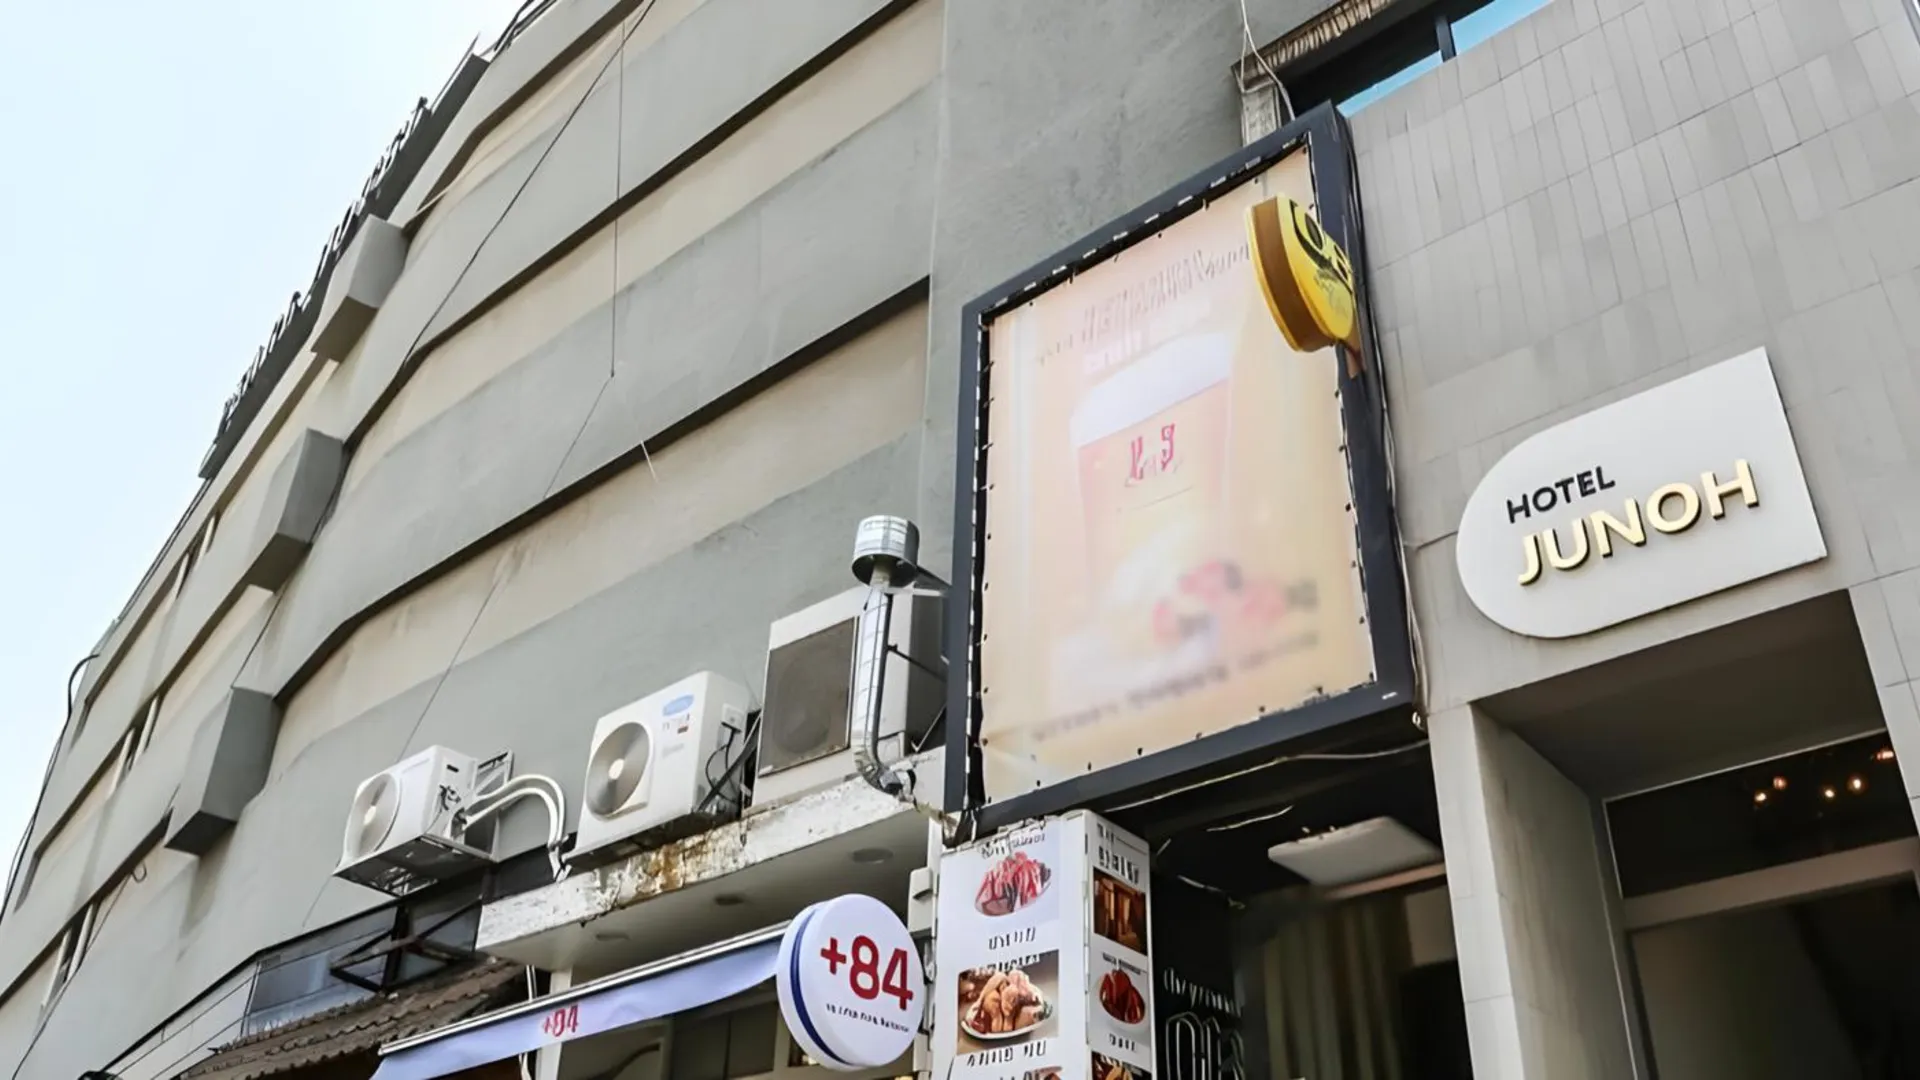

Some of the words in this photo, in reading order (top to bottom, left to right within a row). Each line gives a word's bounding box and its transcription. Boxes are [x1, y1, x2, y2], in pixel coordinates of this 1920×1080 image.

[1507, 466, 1615, 523] HOTEL
[1518, 459, 1759, 586] JUNOH
[820, 935, 913, 1011] +84
